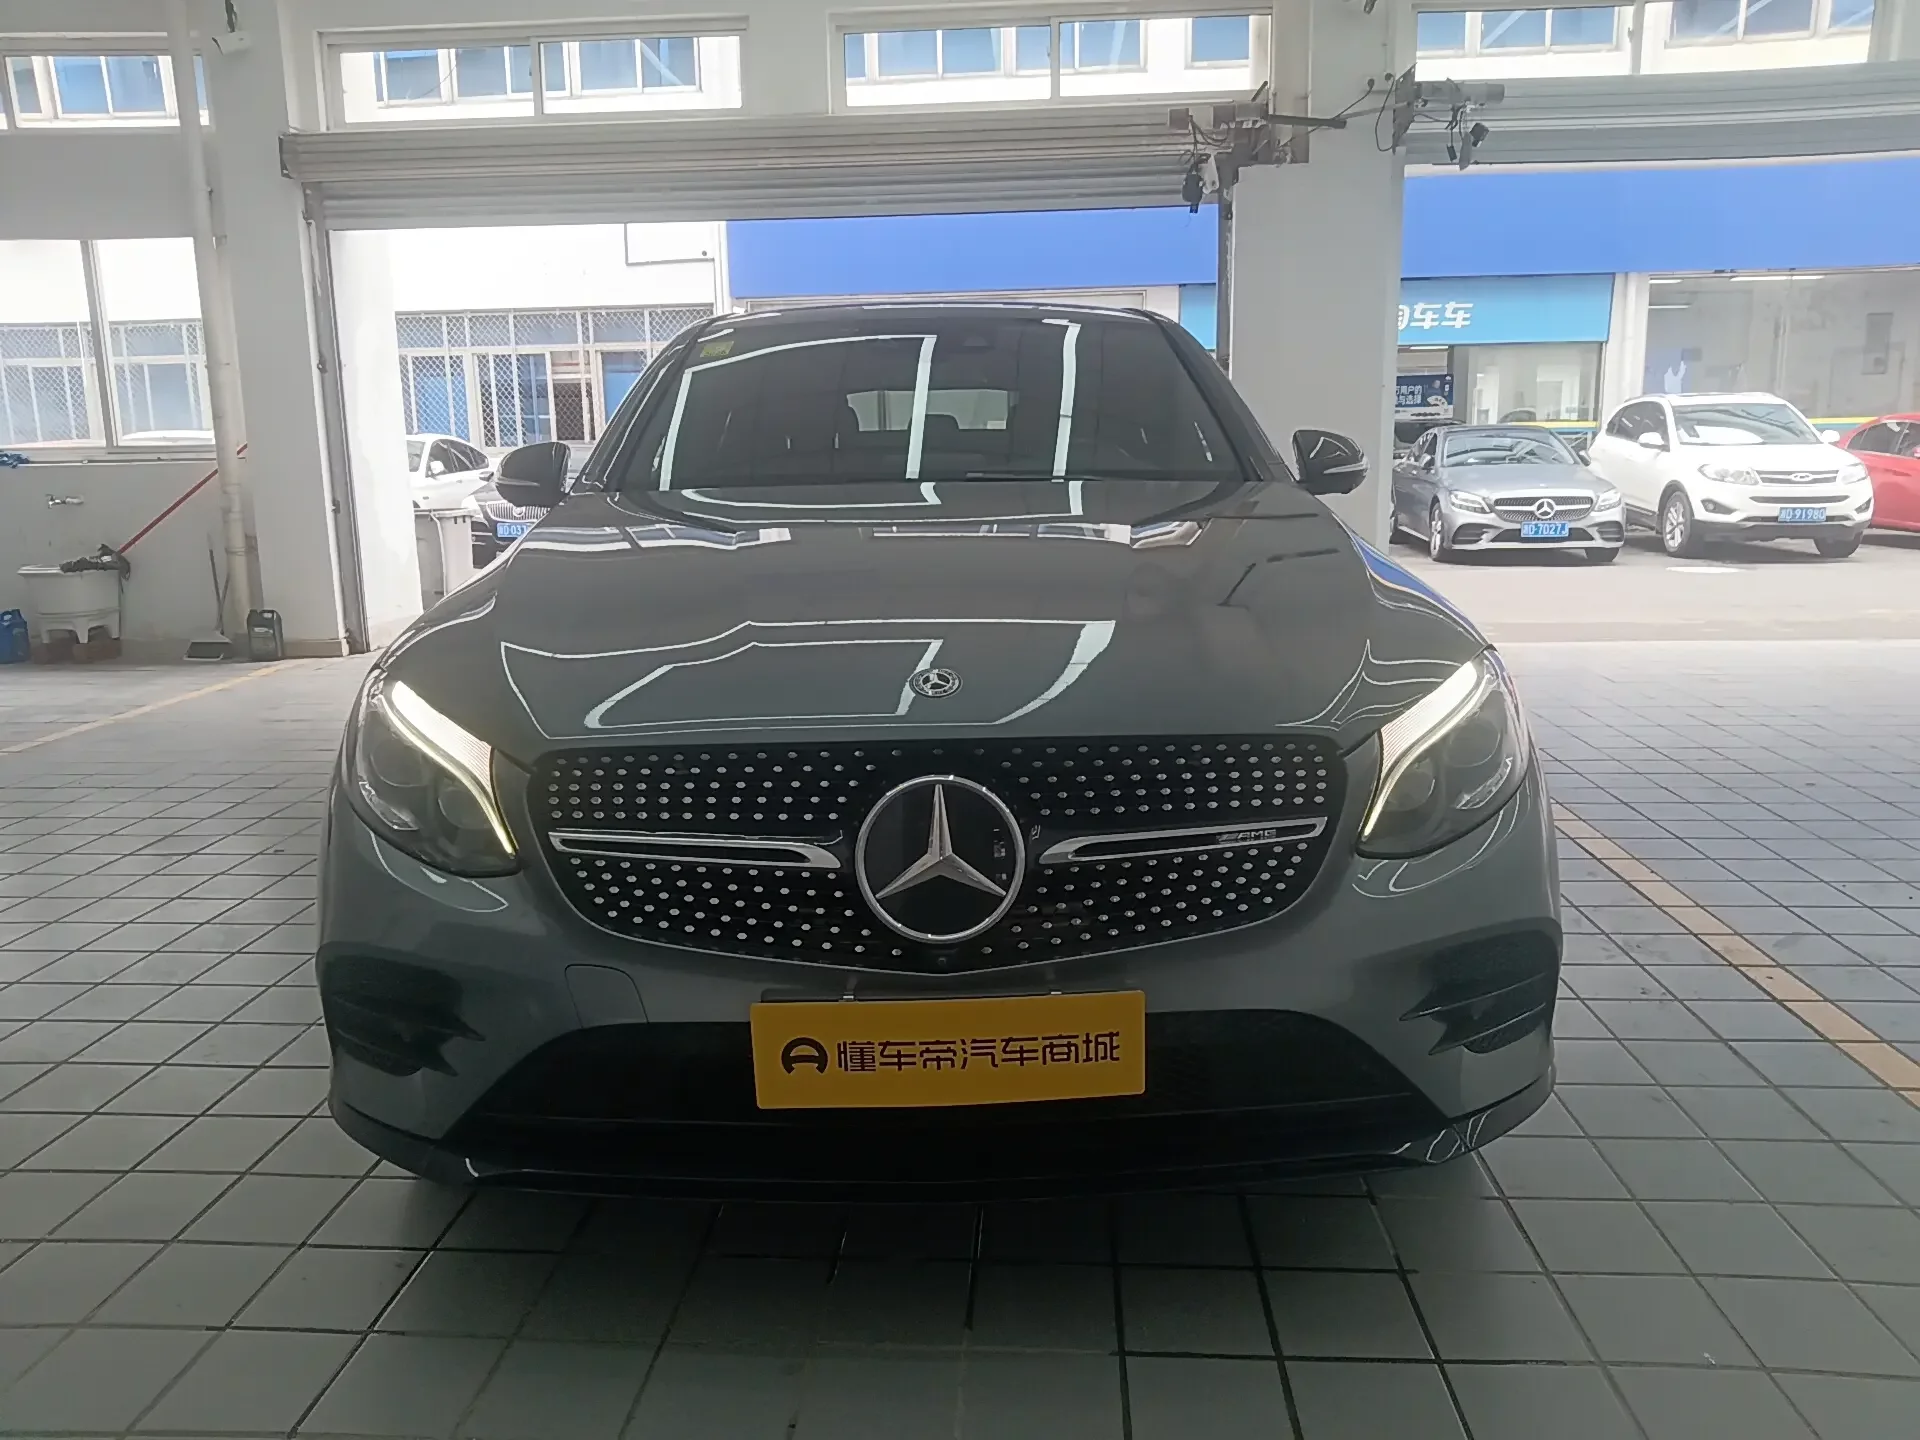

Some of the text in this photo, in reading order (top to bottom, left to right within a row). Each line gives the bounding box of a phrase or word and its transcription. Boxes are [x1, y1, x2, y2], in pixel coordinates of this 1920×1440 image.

[836, 1031, 1121, 1072] 懂车帝汽车商城
